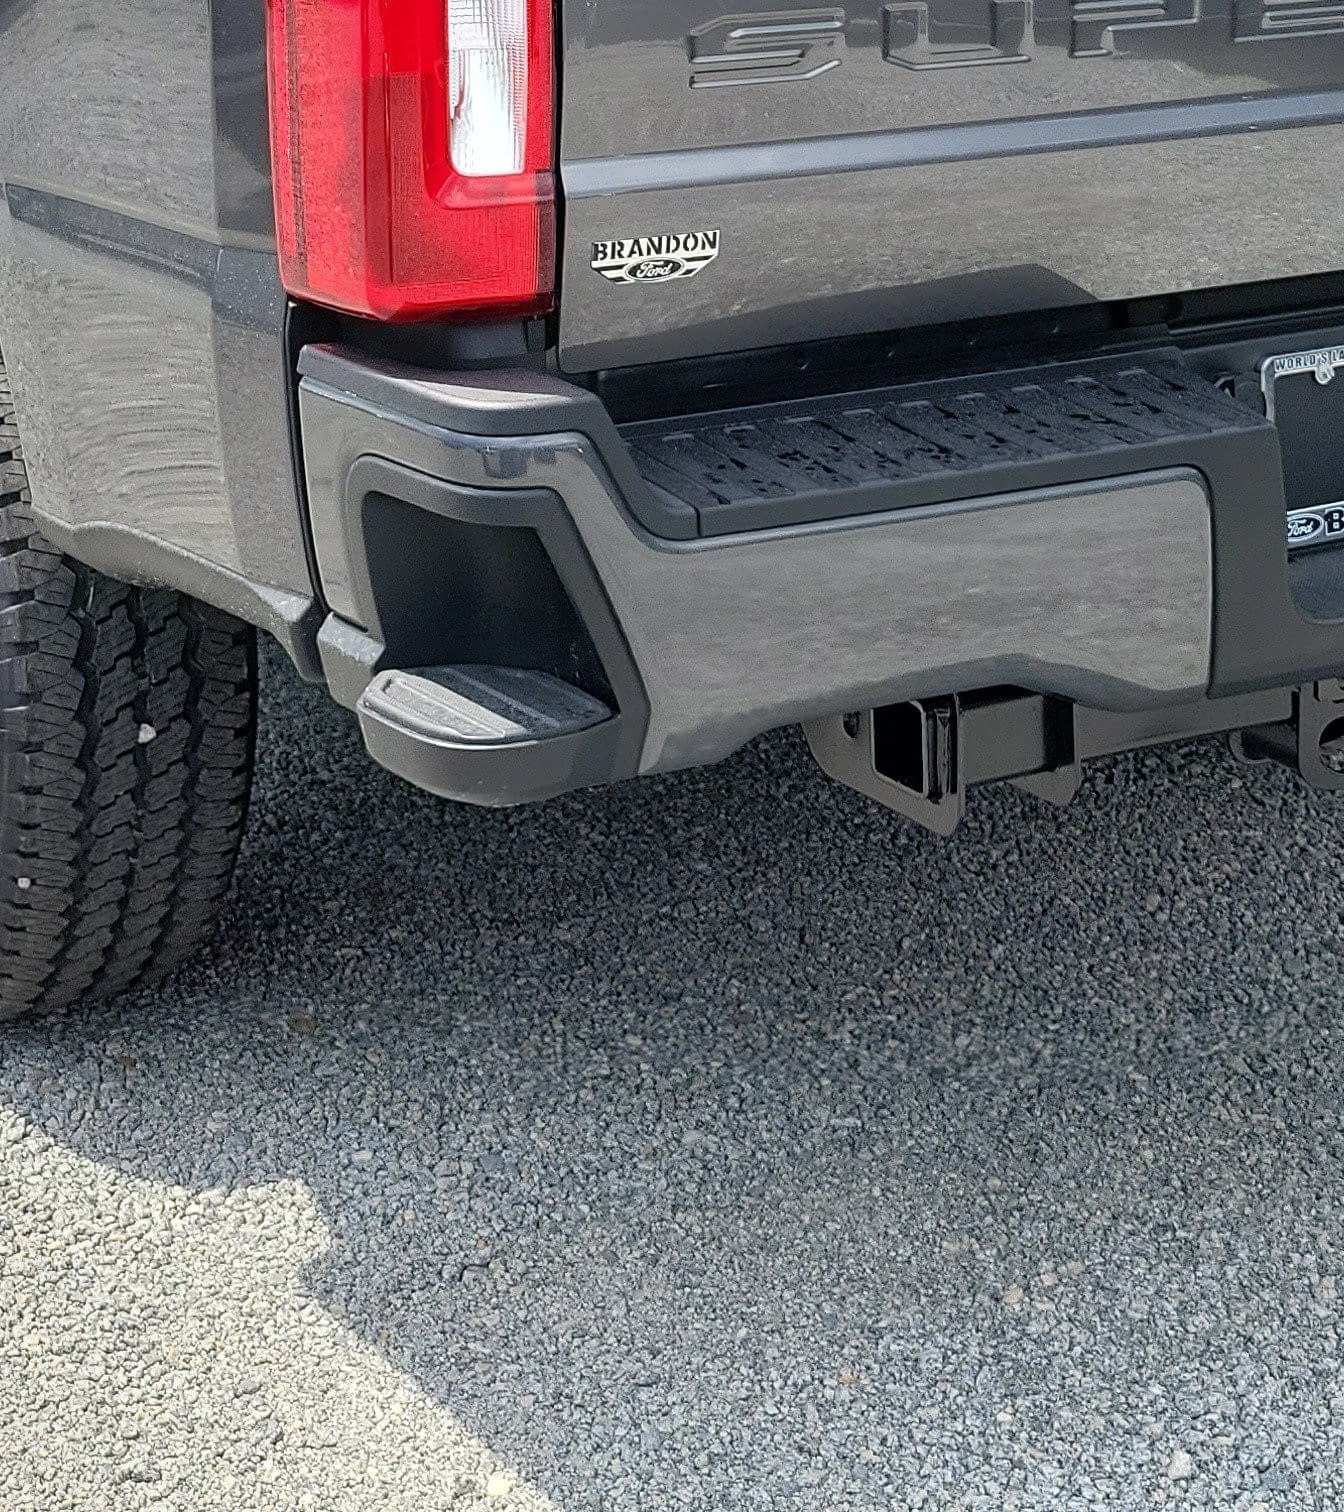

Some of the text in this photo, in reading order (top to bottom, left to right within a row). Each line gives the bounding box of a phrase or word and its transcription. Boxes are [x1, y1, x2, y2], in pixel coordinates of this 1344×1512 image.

[593, 231, 717, 261] BRANDON
[636, 262, 673, 278] Ford
[1276, 352, 1328, 371] WORLD'S
[1288, 517, 1315, 537] Ford
